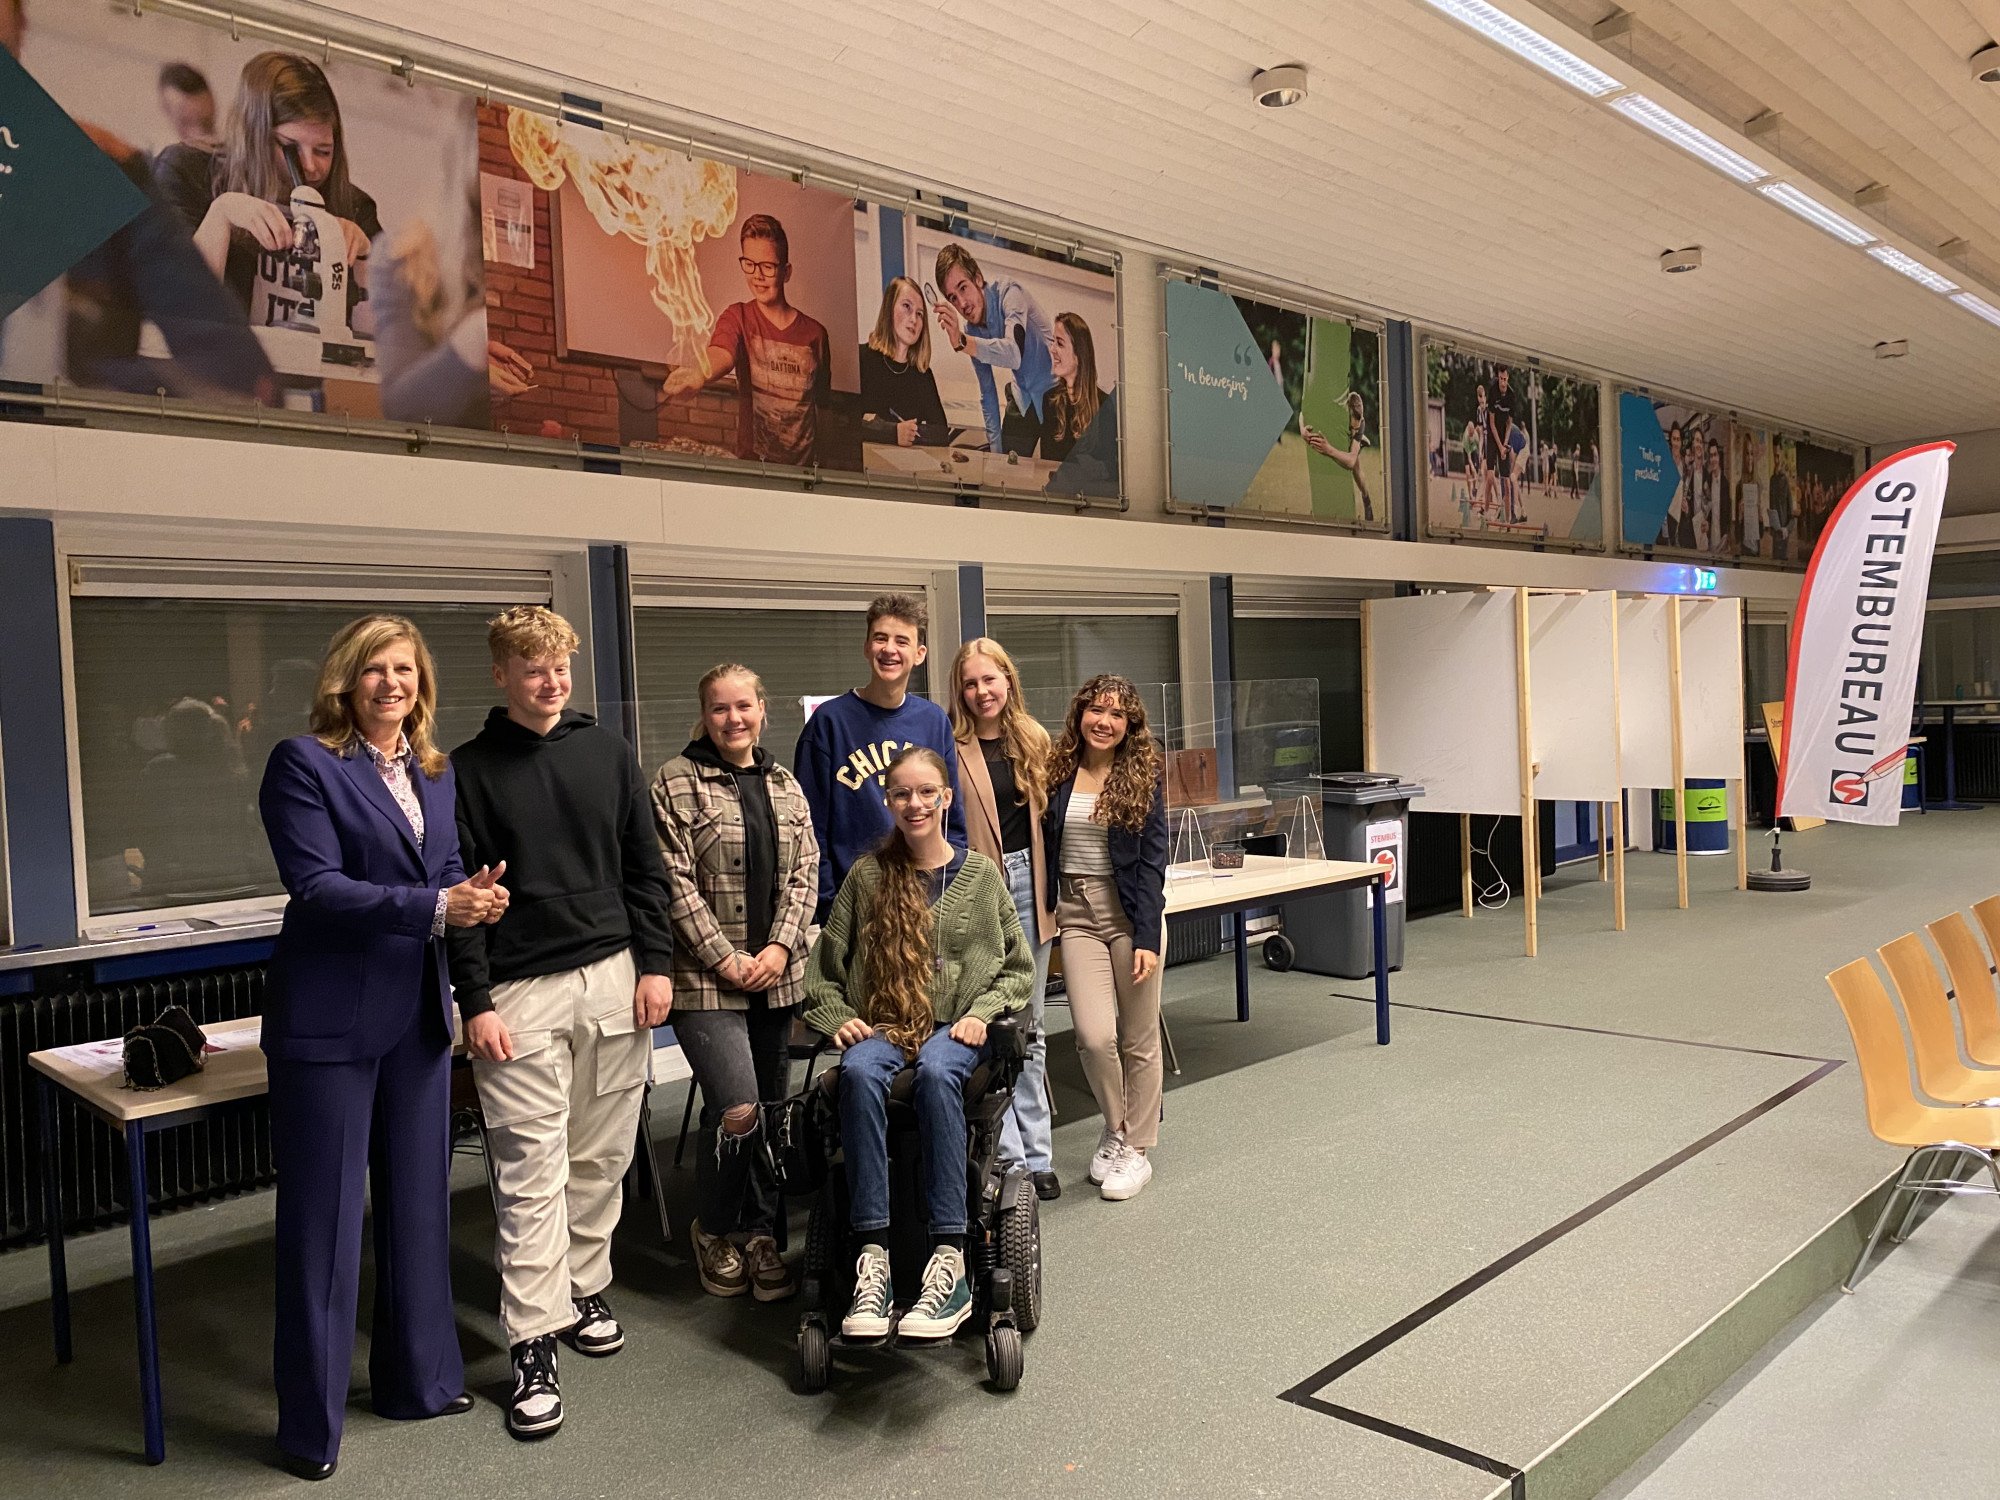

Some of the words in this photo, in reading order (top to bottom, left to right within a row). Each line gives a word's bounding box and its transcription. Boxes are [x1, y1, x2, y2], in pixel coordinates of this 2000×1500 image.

[1834, 480, 1917, 756] STEMBUREAU
[836, 740, 914, 791] CHIC
[1370, 832, 1397, 844] STEMBUS
